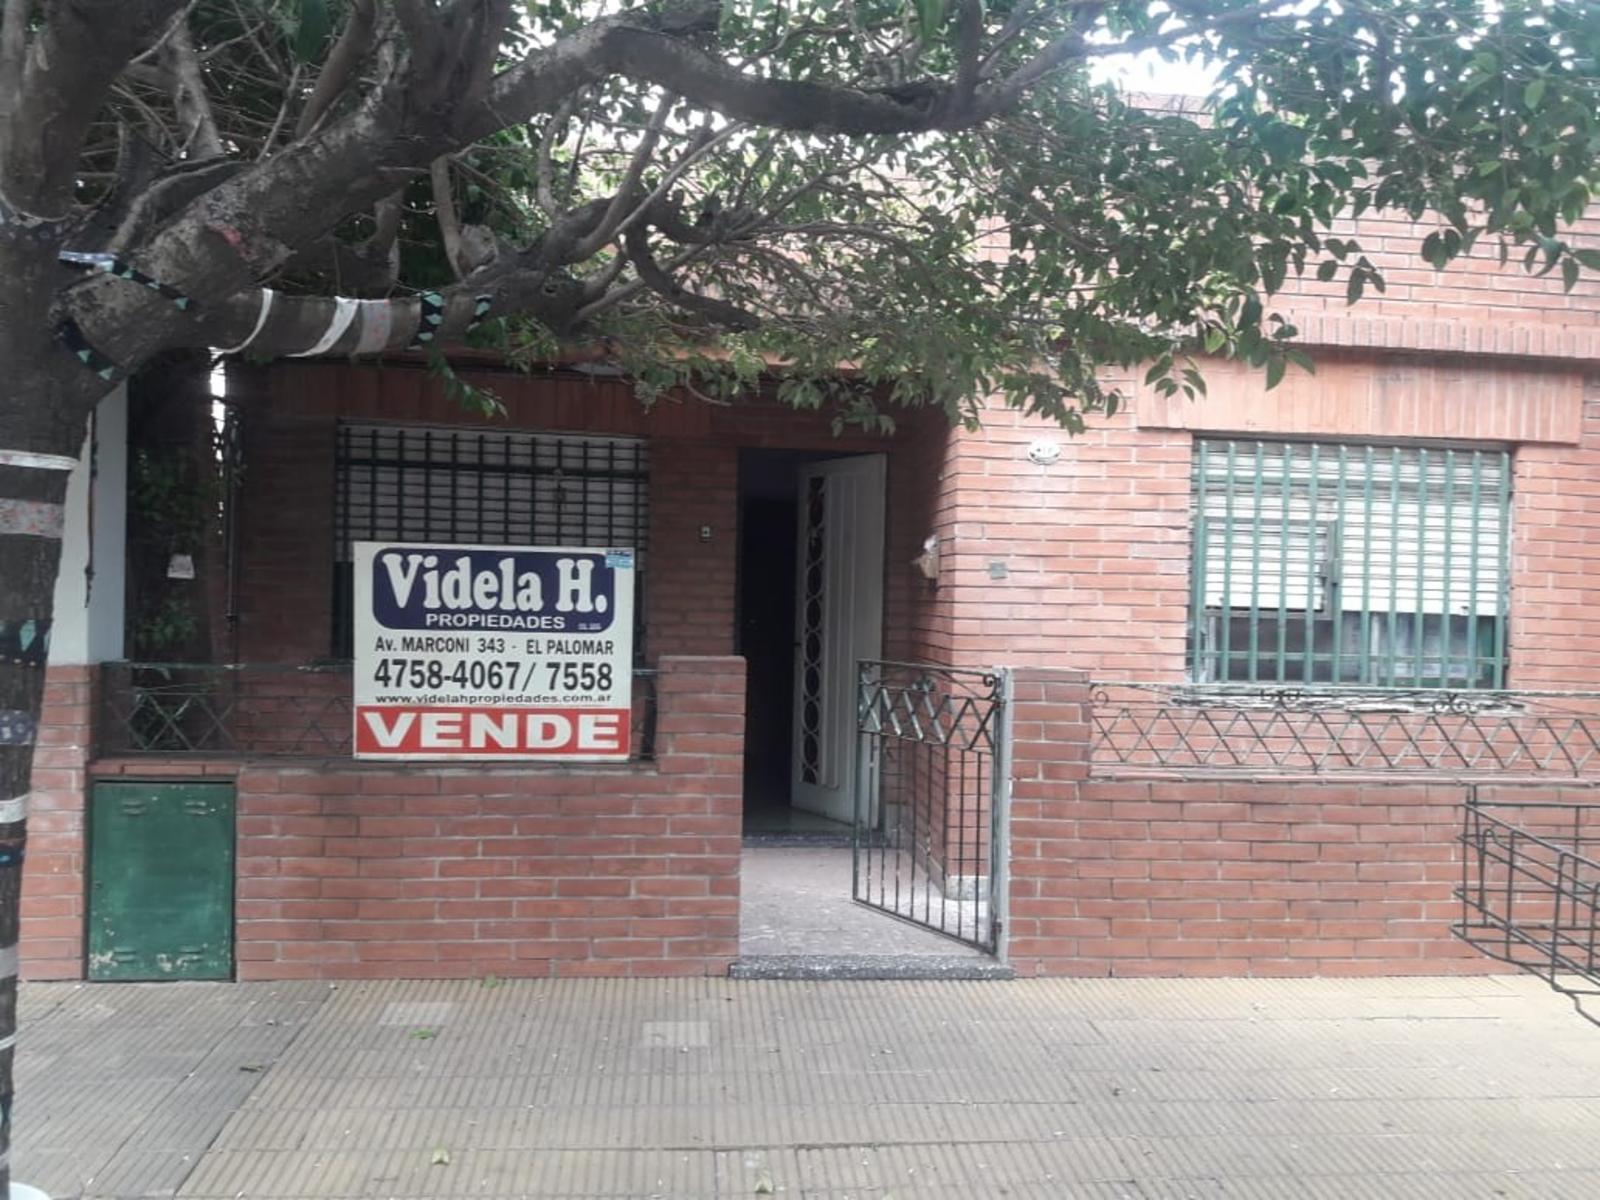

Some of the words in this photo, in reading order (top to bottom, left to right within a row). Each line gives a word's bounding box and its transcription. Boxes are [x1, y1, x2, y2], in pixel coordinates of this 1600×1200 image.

[382, 553, 543, 611] Videla
[555, 558, 608, 613] H.
[426, 613, 566, 629] PROPIEDADES
[402, 637, 469, 653] MARCONI
[477, 638, 505, 653] 343
[526, 639, 542, 655] EL
[547, 640, 614, 656] PALOMAR
[546, 662, 613, 691] 7558
[376, 694, 612, 705] www.videlahpropiedades.com.ar
[363, 712, 620, 749] VENDE
